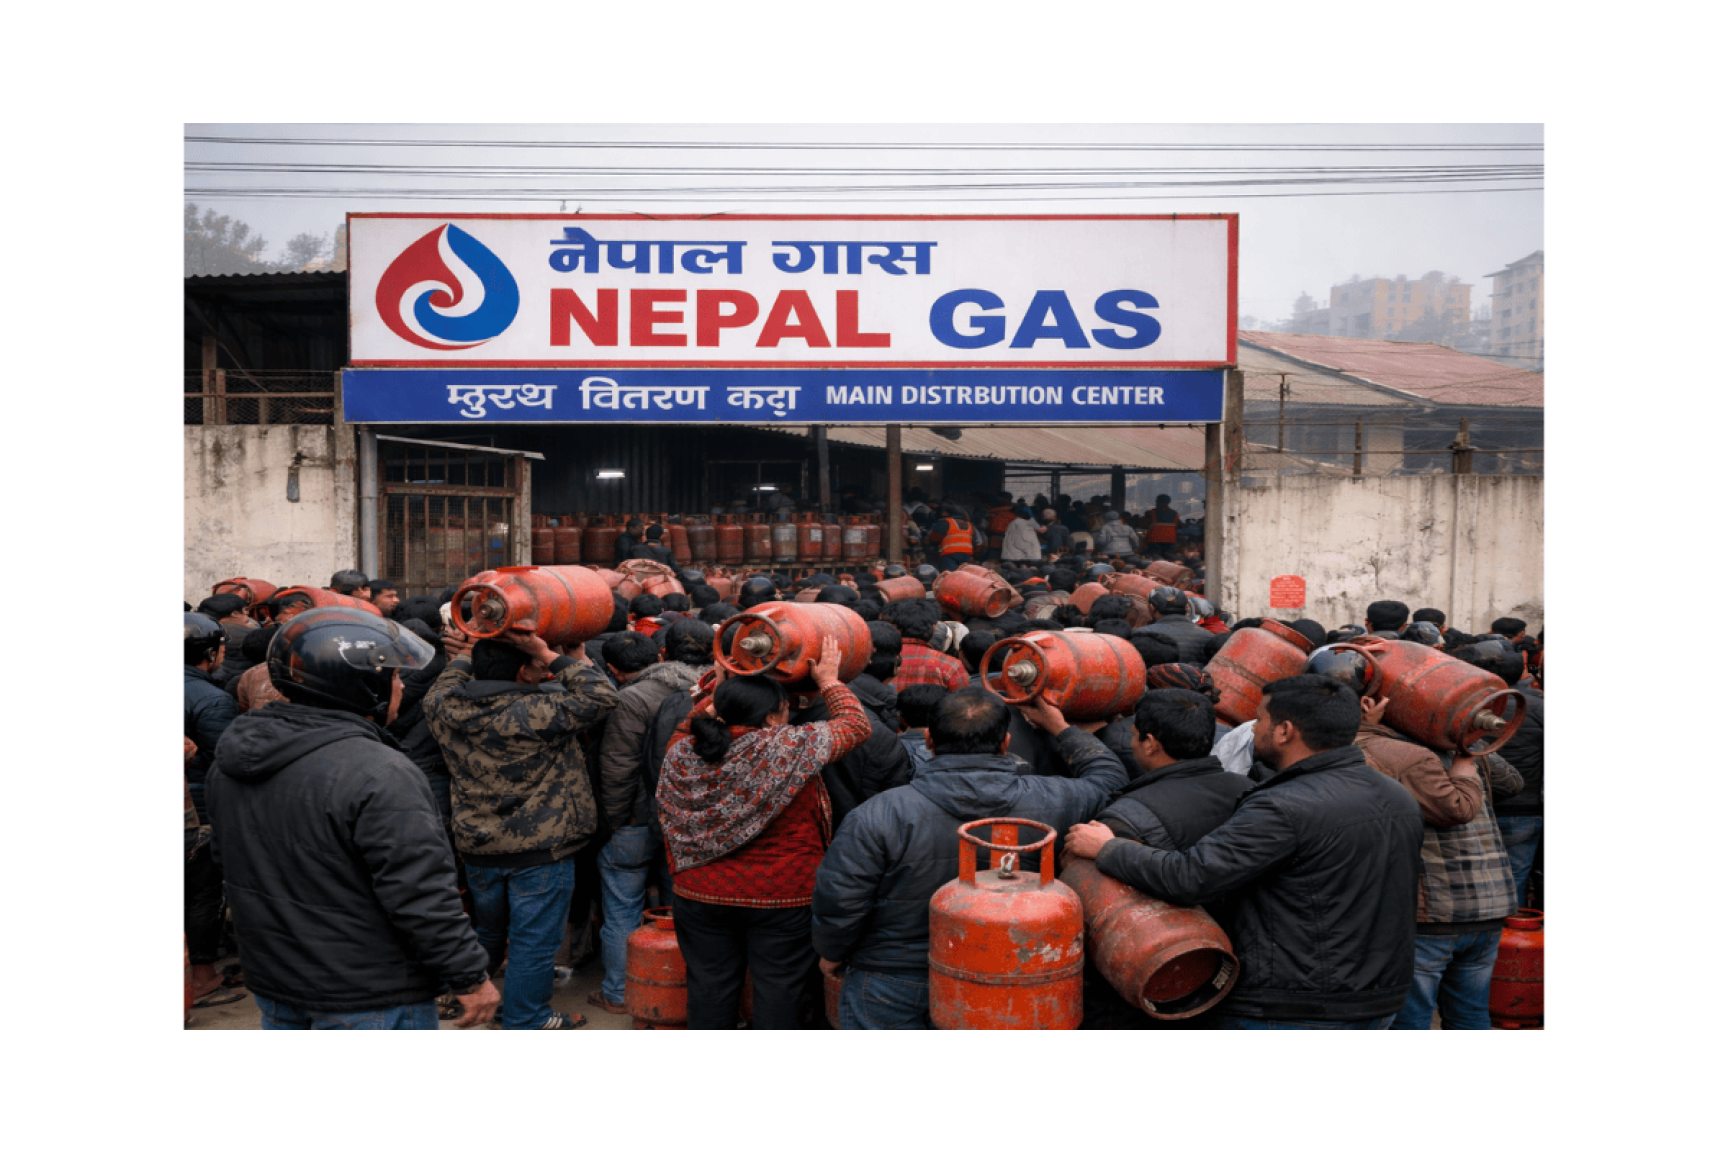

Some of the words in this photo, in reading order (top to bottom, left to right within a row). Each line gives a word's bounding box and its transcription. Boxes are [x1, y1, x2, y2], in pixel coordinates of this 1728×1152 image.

[548, 228, 747, 275] नेपाल
[549, 288, 891, 348] NEPAL
[929, 288, 1162, 349] GAS
[578, 376, 711, 410] वितरण
[826, 385, 893, 405] MAIN
[901, 385, 1063, 405] DISTRBUTION
[1071, 385, 1165, 405] CENTER
